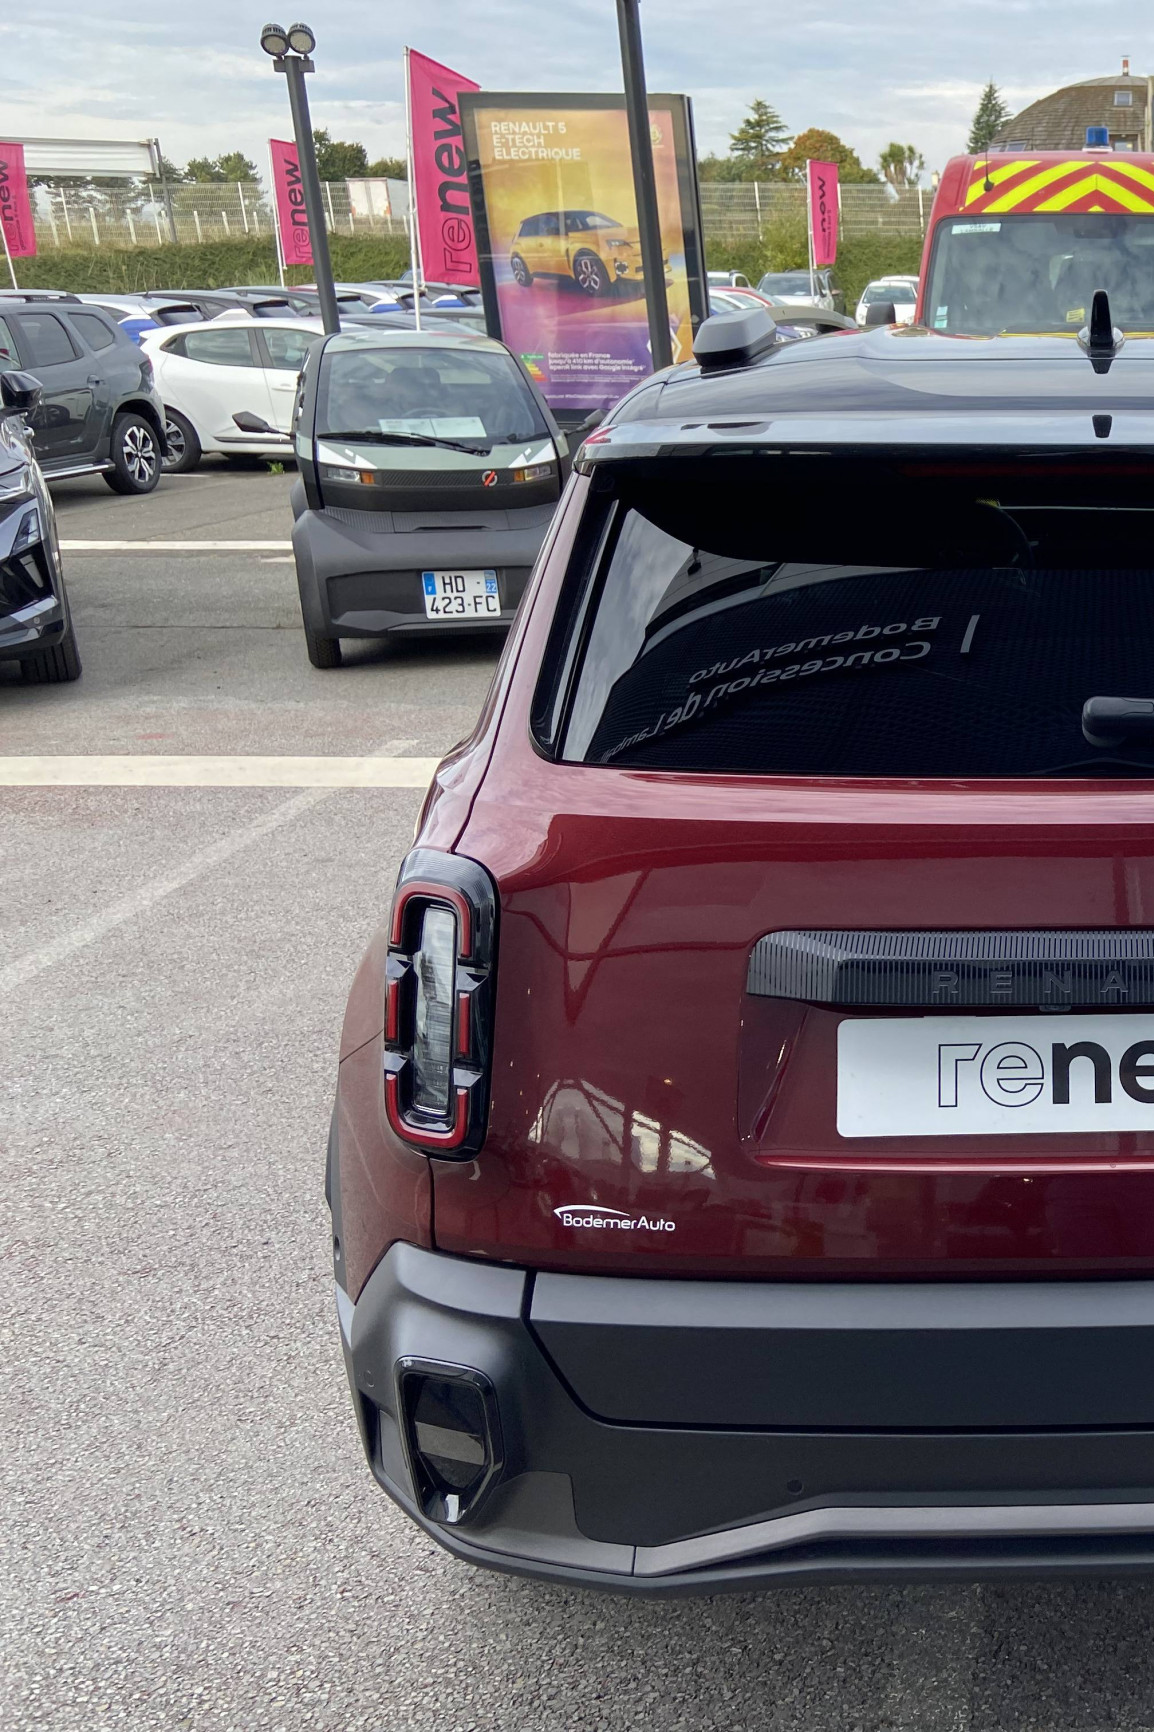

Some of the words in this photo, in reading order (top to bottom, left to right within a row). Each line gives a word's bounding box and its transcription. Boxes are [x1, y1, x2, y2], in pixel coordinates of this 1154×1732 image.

[491, 122, 555, 133] RENAULT
[558, 122, 566, 133] 5
[493, 134, 544, 147] E-TECH
[432, 87, 472, 273] renew
[284, 159, 312, 259] renew
[441, 575, 466, 593] HD
[486, 583, 497, 591] 22
[430, 595, 497, 614] 423-FC
[563, 1213, 676, 1232] BodemerAuto
